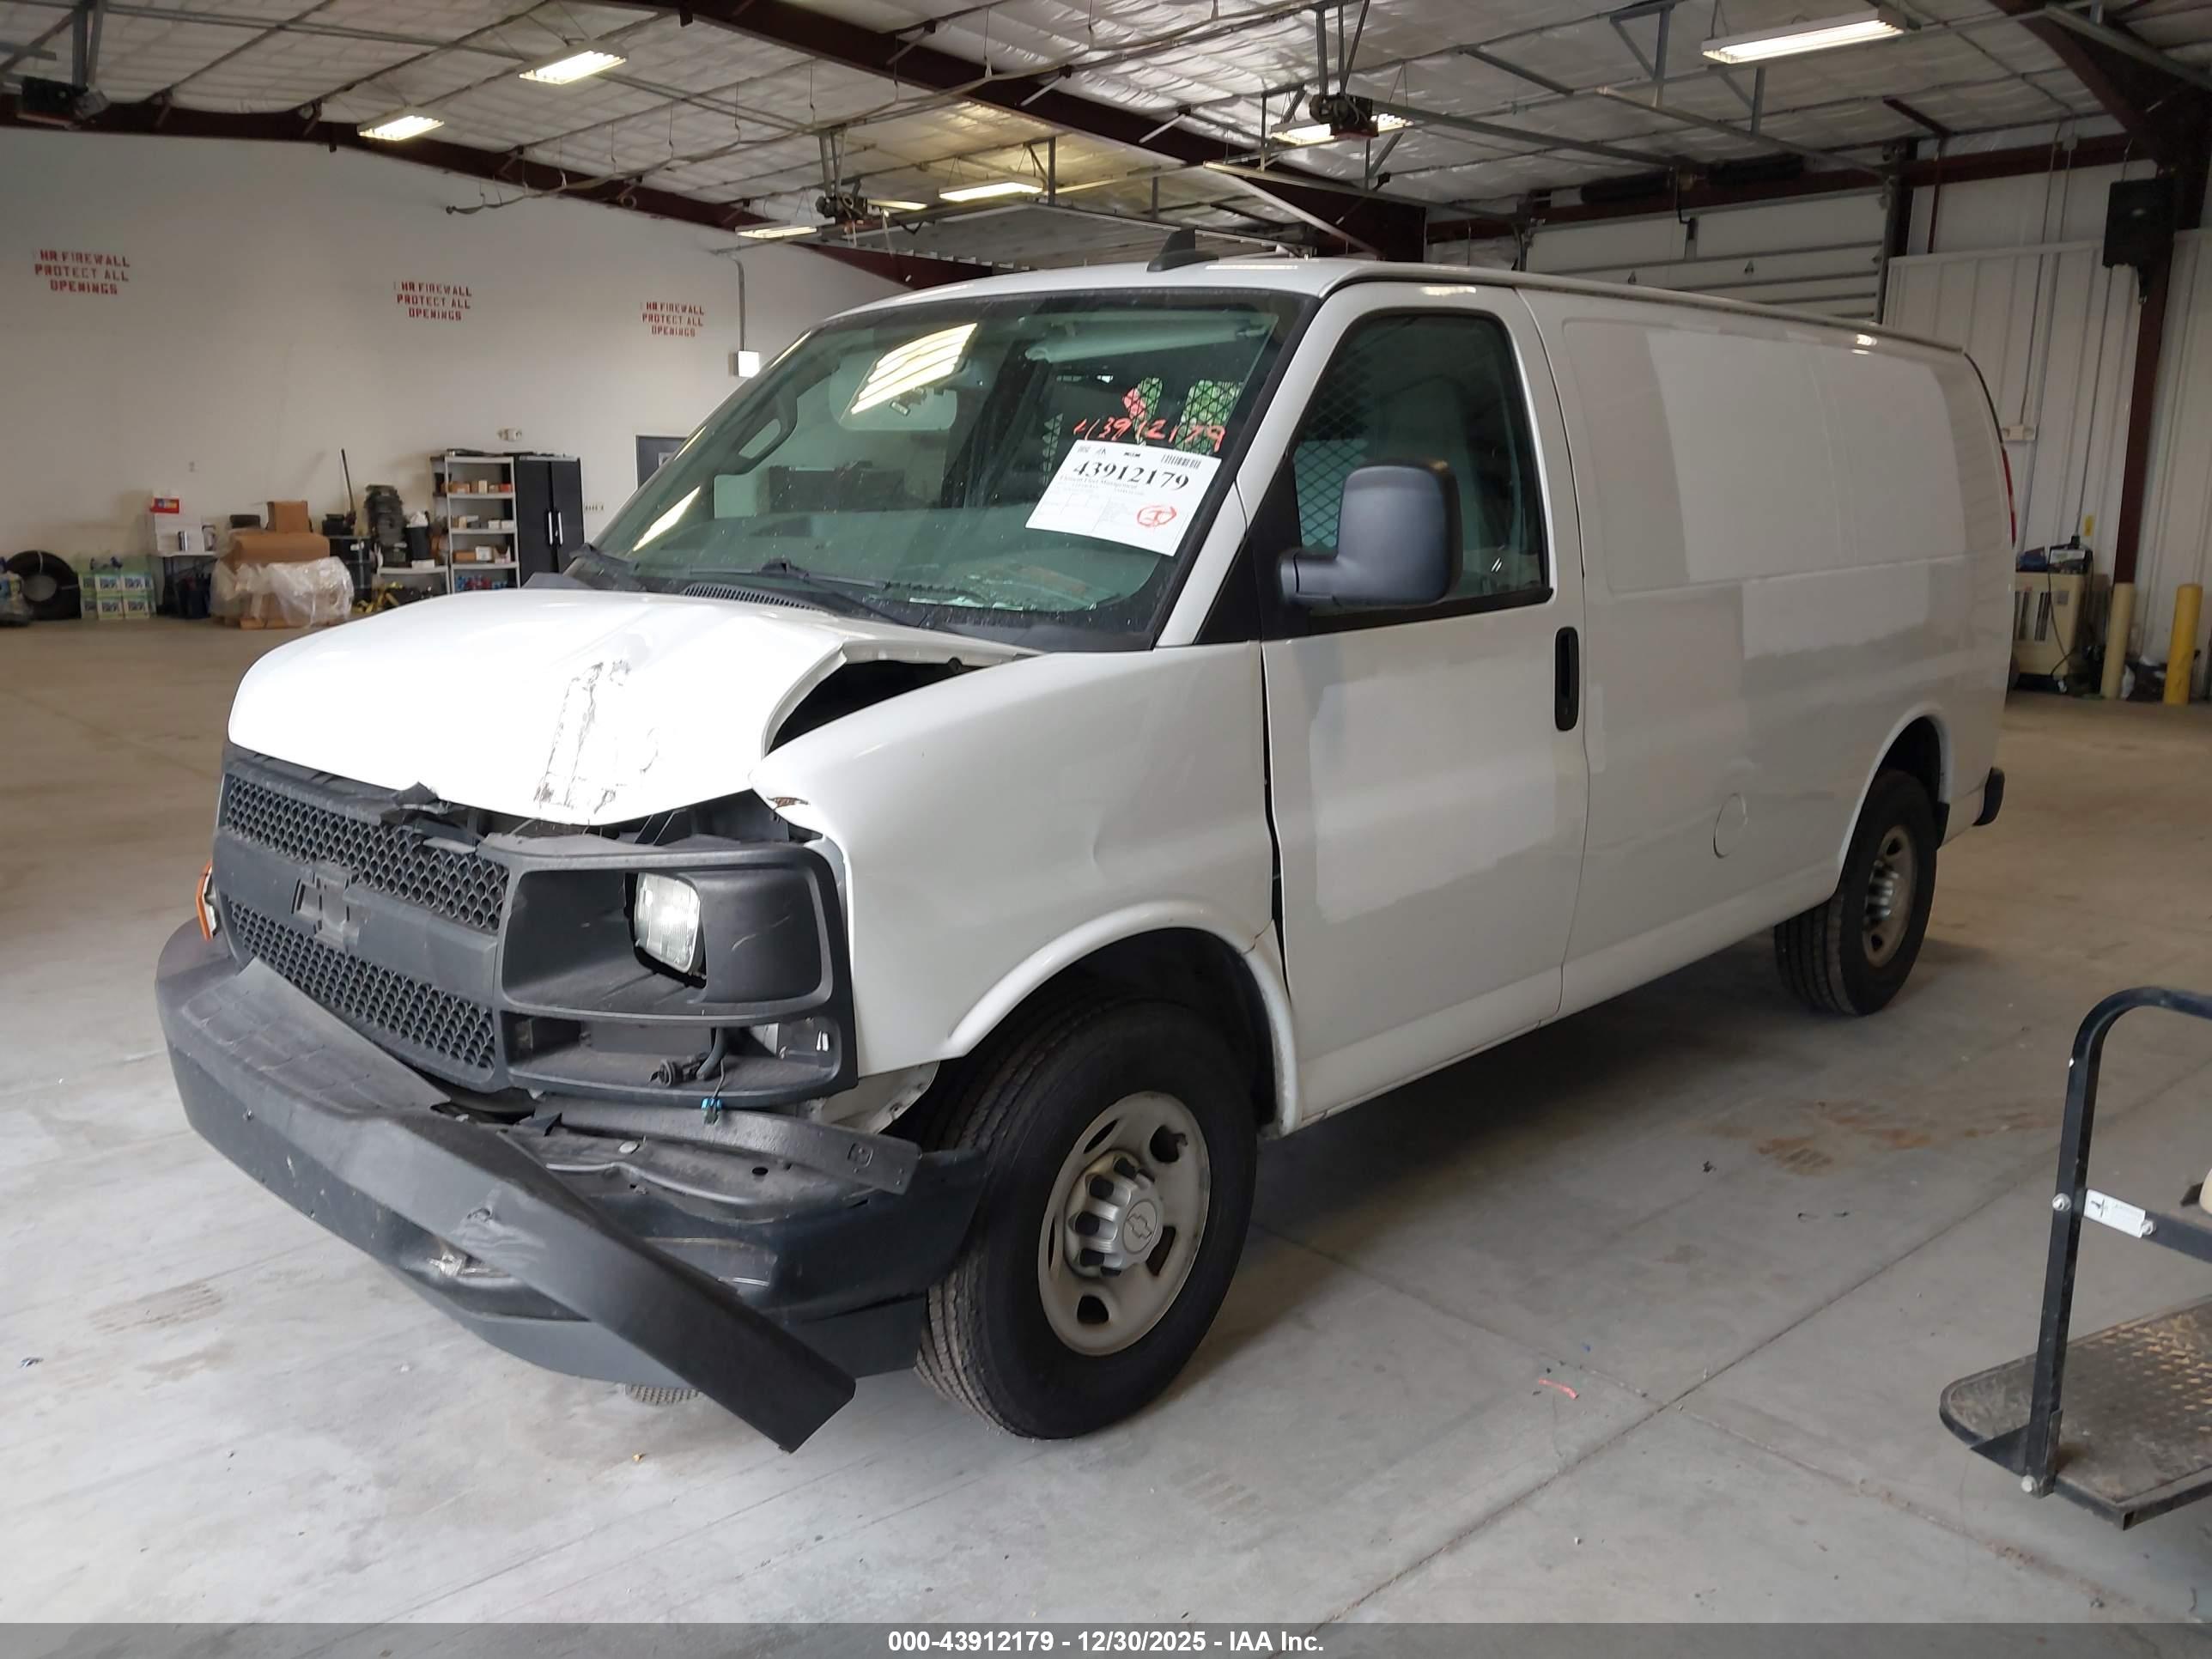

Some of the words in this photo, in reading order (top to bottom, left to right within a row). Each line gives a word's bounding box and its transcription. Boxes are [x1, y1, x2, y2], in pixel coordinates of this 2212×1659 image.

[40, 249, 58, 261] HR
[62, 251, 131, 268] FIREWALL
[34, 264, 97, 279] PROTECT
[104, 269, 129, 282] ALL
[50, 279, 118, 295] OPENINGS
[401, 281, 416, 291] HR
[418, 282, 472, 296] FIREWALL
[397, 294, 446, 307] PROTECT
[452, 297, 471, 309] ALL
[660, 301, 705, 316] FIREWALL
[409, 307, 462, 320] OPENINGS
[641, 313, 683, 325] PROTECT
[687, 317, 704, 326] ALL
[651, 325, 696, 337] OPENINGS
[1074, 460, 1189, 491] 43912179
